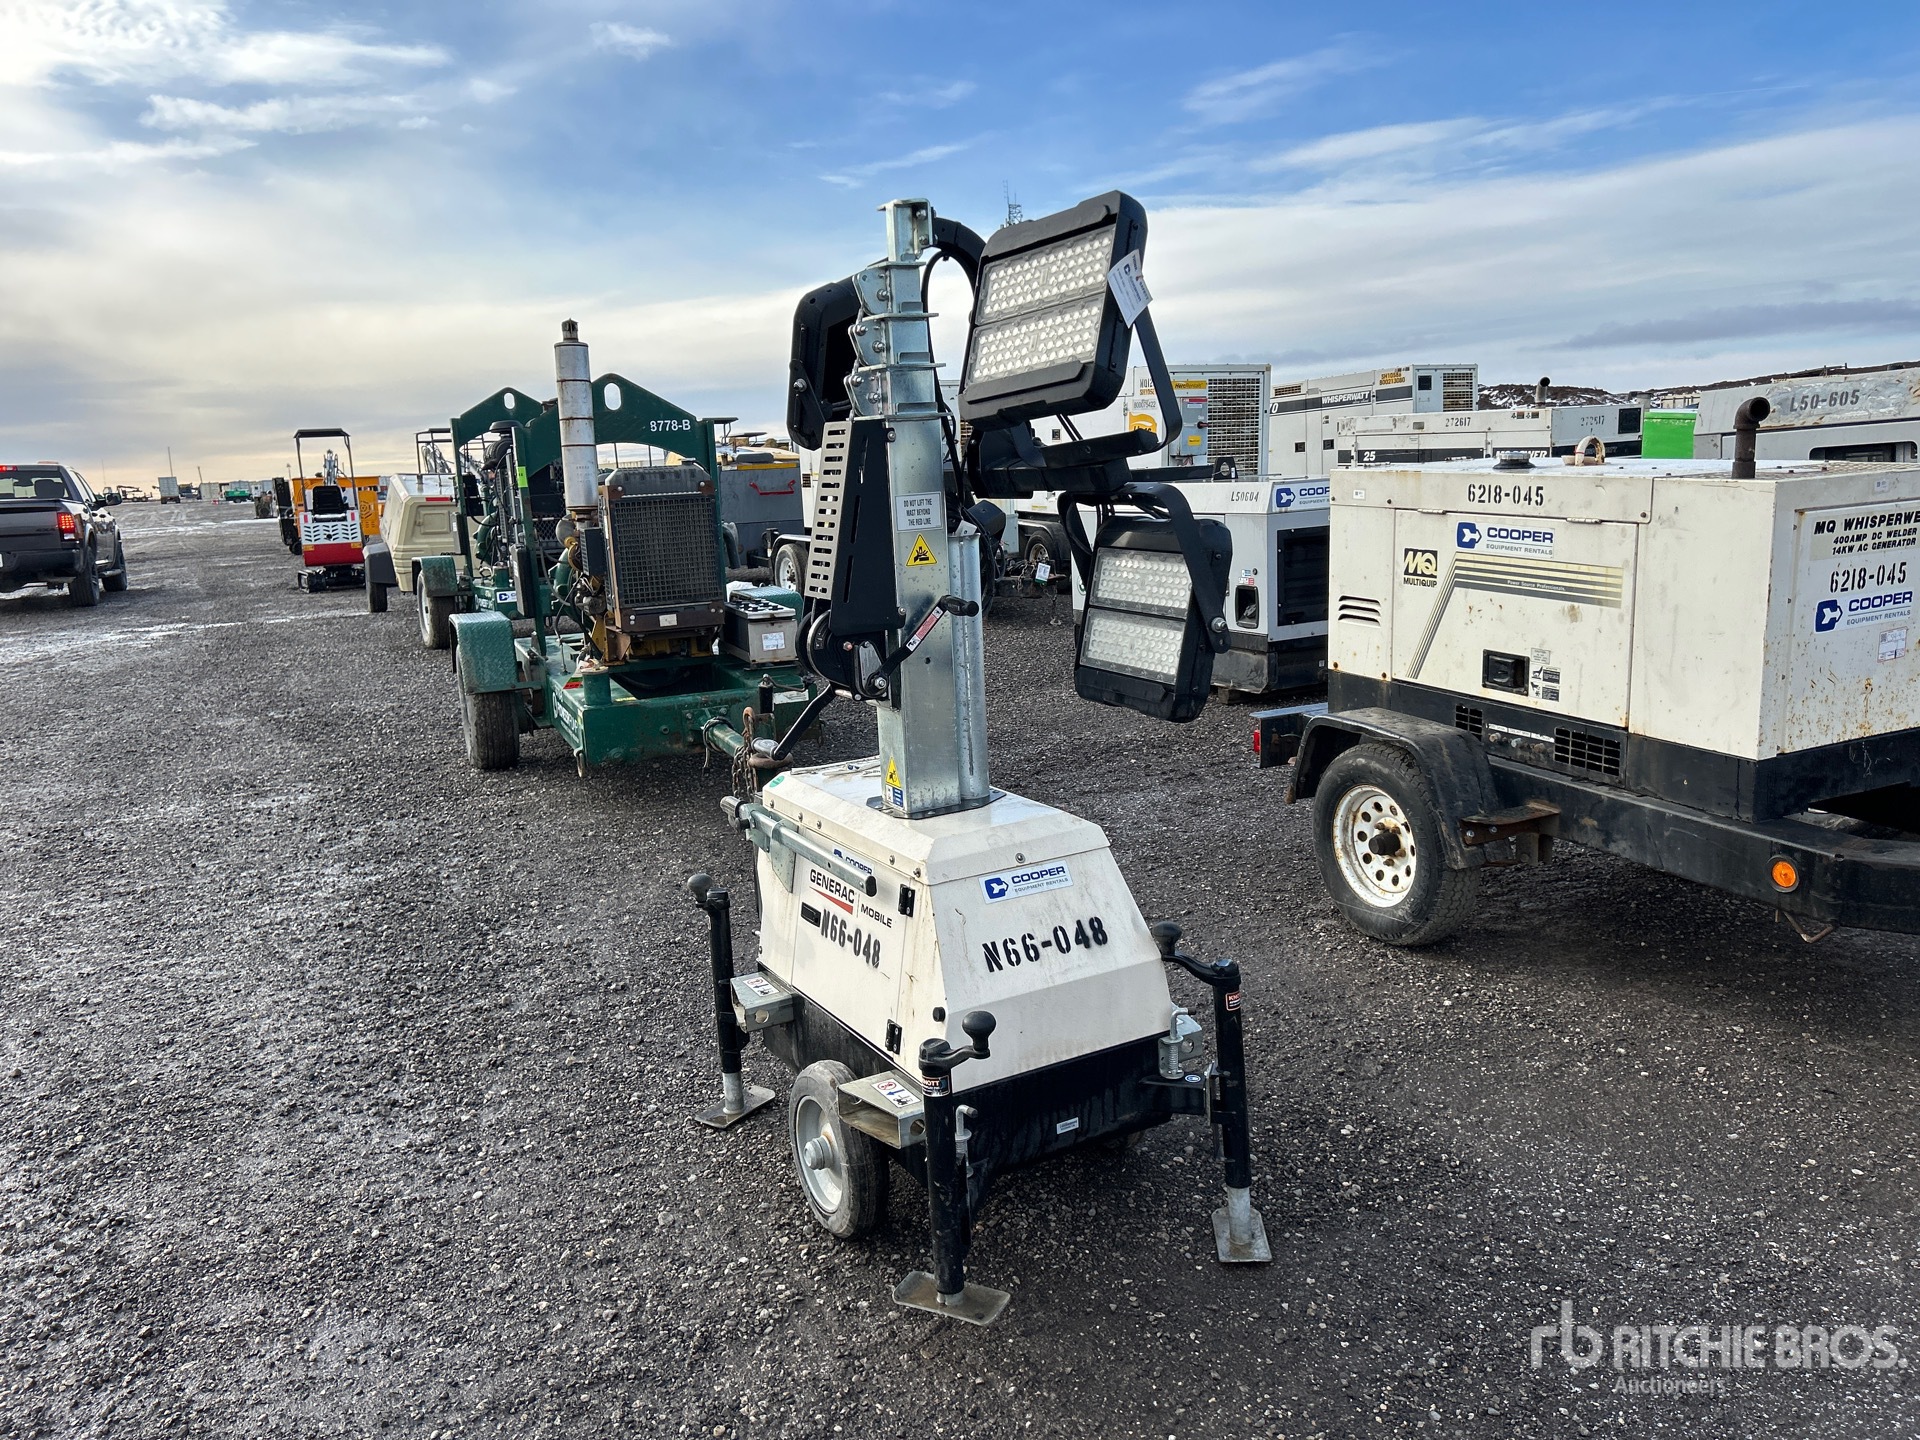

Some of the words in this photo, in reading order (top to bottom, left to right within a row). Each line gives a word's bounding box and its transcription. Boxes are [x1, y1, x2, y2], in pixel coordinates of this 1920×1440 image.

[1321, 391, 1370, 404] WHISPERWATT
[1789, 389, 1860, 412] L50-605
[650, 419, 691, 432] 8778-B
[1445, 417, 1471, 427] 272617
[1363, 451, 1376, 462] 25
[1467, 483, 1545, 507] 6218-045
[1813, 519, 1837, 535] MQ
[1843, 510, 1920, 532] WHISPERWE
[1486, 526, 1554, 544] COOPER
[1833, 533, 1868, 545] 400AMP
[1871, 531, 1883, 541] DC
[1886, 527, 1918, 539] WELDER
[1485, 543, 1523, 554] EQUIPMENT
[1523, 546, 1553, 556] RENTALS
[1832, 545, 1855, 555] 14KW
[1857, 543, 1869, 553] AC
[1871, 537, 1917, 551] GENERATOR
[1403, 550, 1438, 576] MQ
[1402, 576, 1438, 588] MULTIQUIP
[1829, 561, 1908, 594] 6218-045
[1848, 590, 1913, 613] COOPER
[1846, 614, 1883, 626] EQUIPMENT
[1884, 609, 1911, 620] RENTALS
[1011, 865, 1066, 885] COOPER
[809, 868, 855, 904] GENERAC
[1014, 882, 1045, 893] EQUIPMENT
[1046, 877, 1069, 887] RENTALS
[860, 903, 893, 929] MOBILE
[820, 908, 881, 969] N66-048
[982, 916, 1108, 973] N66-048
